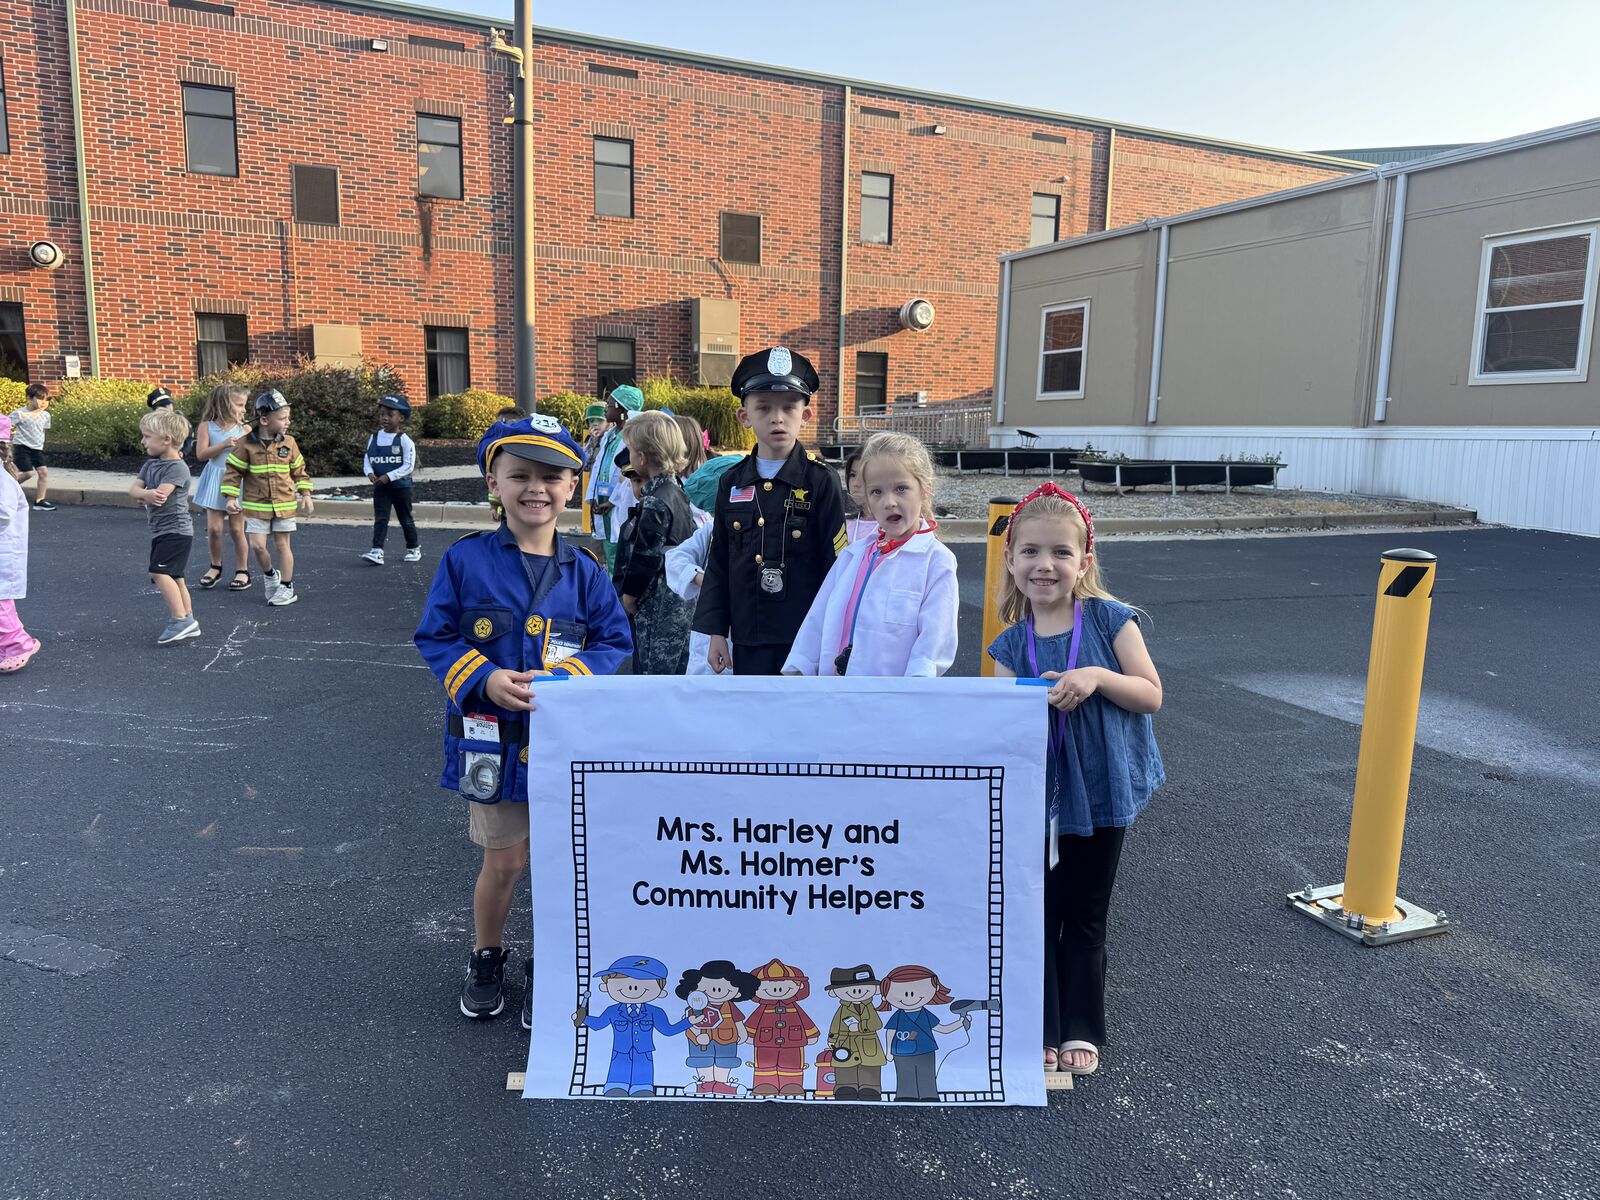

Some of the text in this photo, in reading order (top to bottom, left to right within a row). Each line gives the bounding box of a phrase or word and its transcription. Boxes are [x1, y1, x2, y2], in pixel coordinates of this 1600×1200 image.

[369, 456, 402, 464] POLICE
[657, 817, 899, 850] Mrs. Harley and
[681, 850, 875, 877] Ms. Holmer's
[633, 881, 925, 916] Community Helpers
